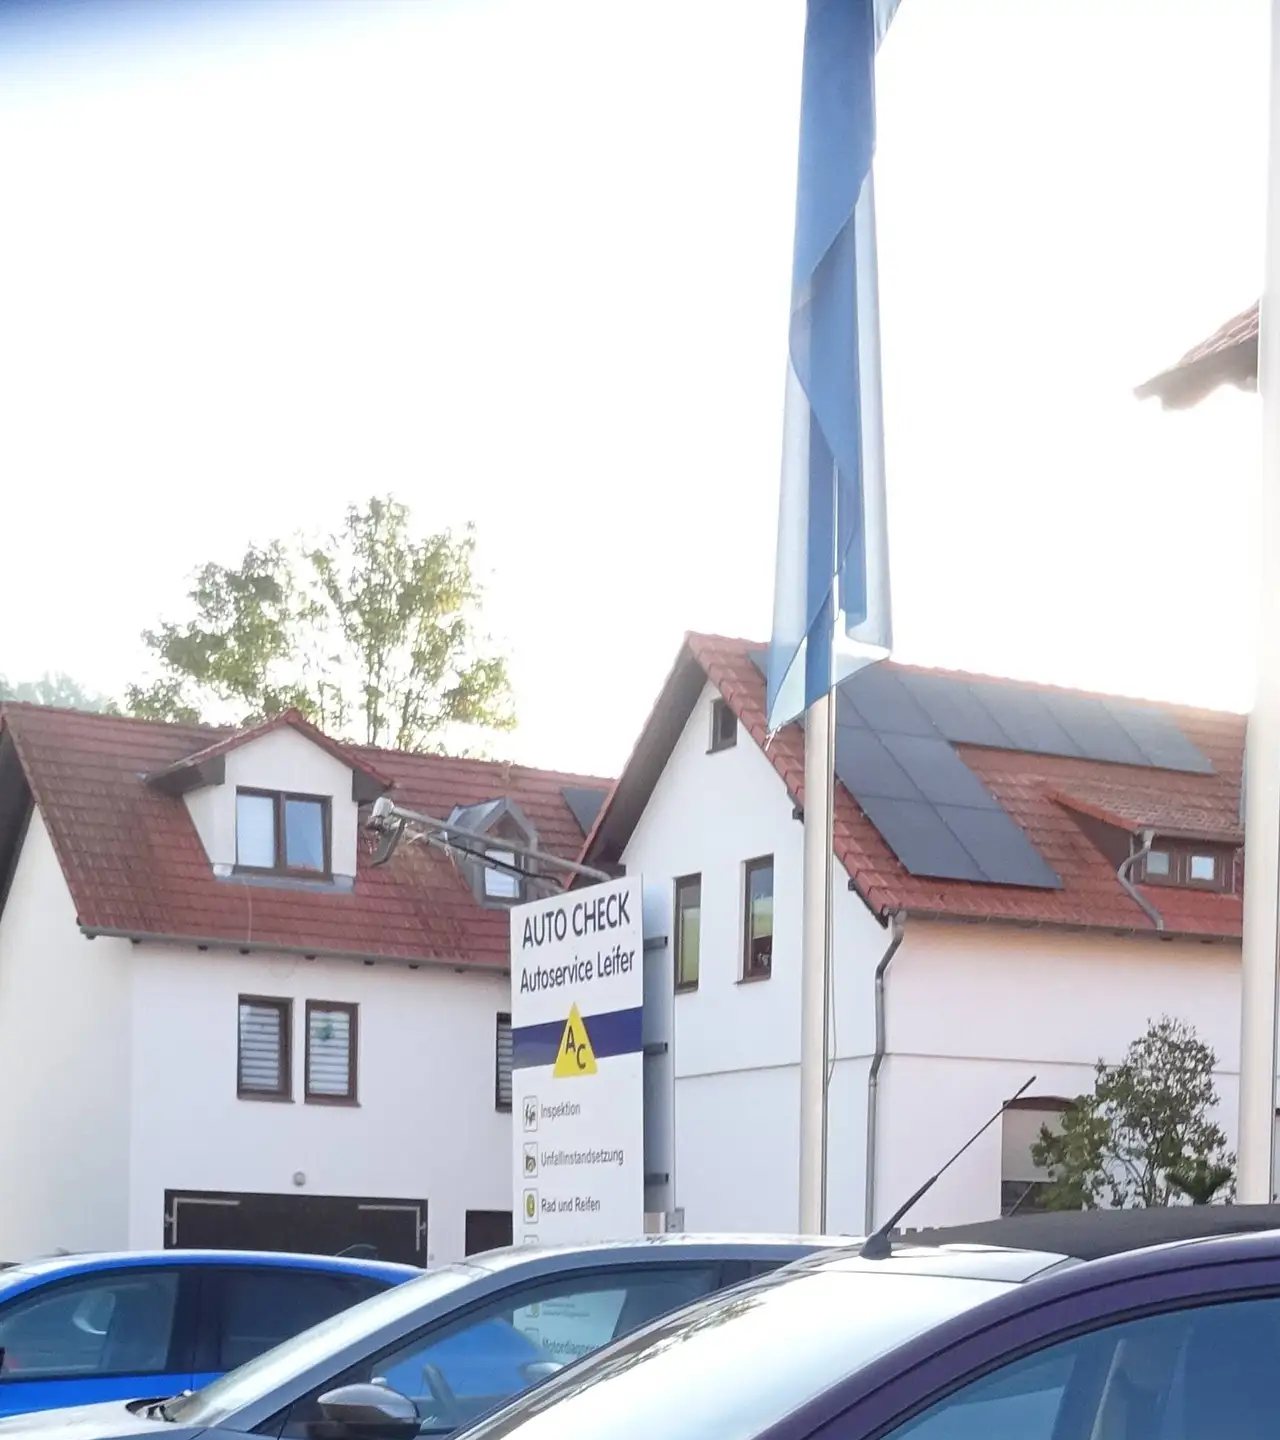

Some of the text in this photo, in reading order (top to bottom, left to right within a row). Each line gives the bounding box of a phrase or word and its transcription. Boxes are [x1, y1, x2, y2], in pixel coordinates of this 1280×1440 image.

[522, 890, 631, 950] AUTO CHECK
[520, 944, 636, 994] Autoservice Leifer
[540, 1101, 581, 1121] Inspektion
[540, 1148, 624, 1167] Unfallinstandsetzung
[541, 1196, 601, 1213] Rad und Reifen
